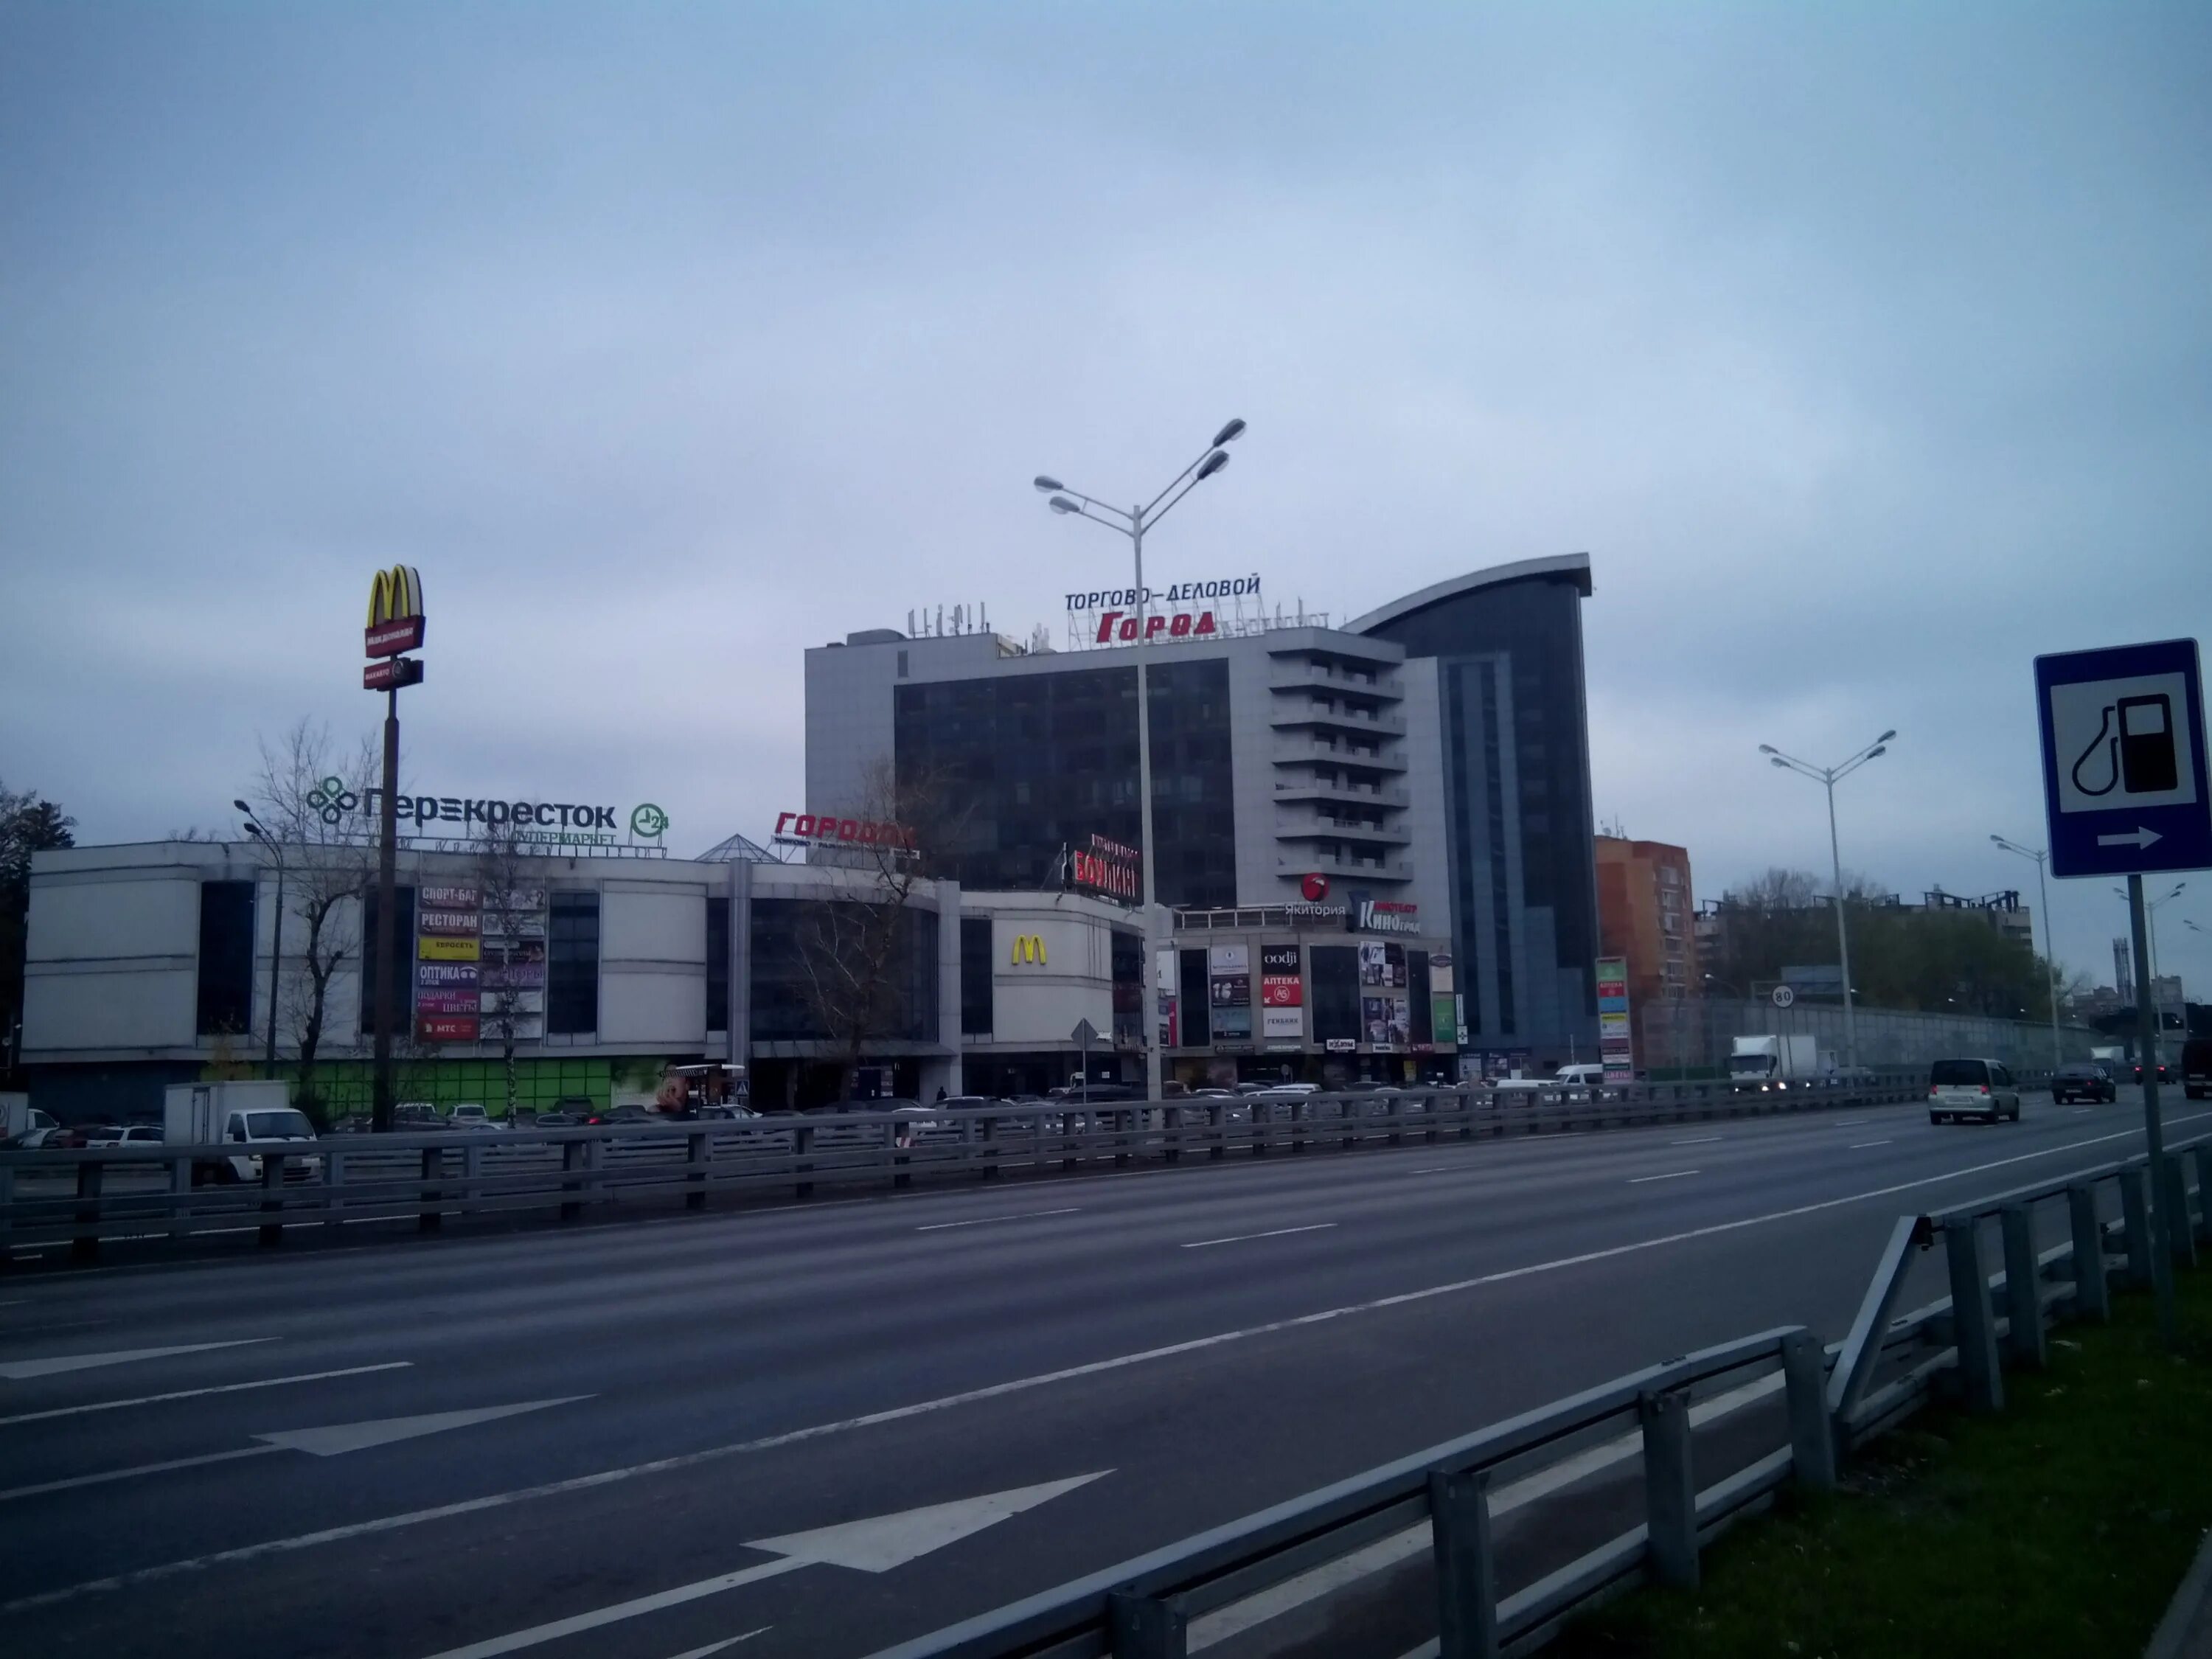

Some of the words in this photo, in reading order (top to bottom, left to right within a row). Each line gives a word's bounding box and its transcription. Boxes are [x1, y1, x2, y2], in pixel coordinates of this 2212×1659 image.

[1285, 904, 1345, 917] Якитория
[422, 914, 478, 928] РЕСТОРАН
[1265, 950, 1297, 967] oodji
[420, 967, 459, 979] ОПТИКА
[1264, 977, 1299, 985] АПТЕКА
[1775, 991, 1791, 1001] 80
[443, 1003, 477, 1012] ЦВЕТЫ
